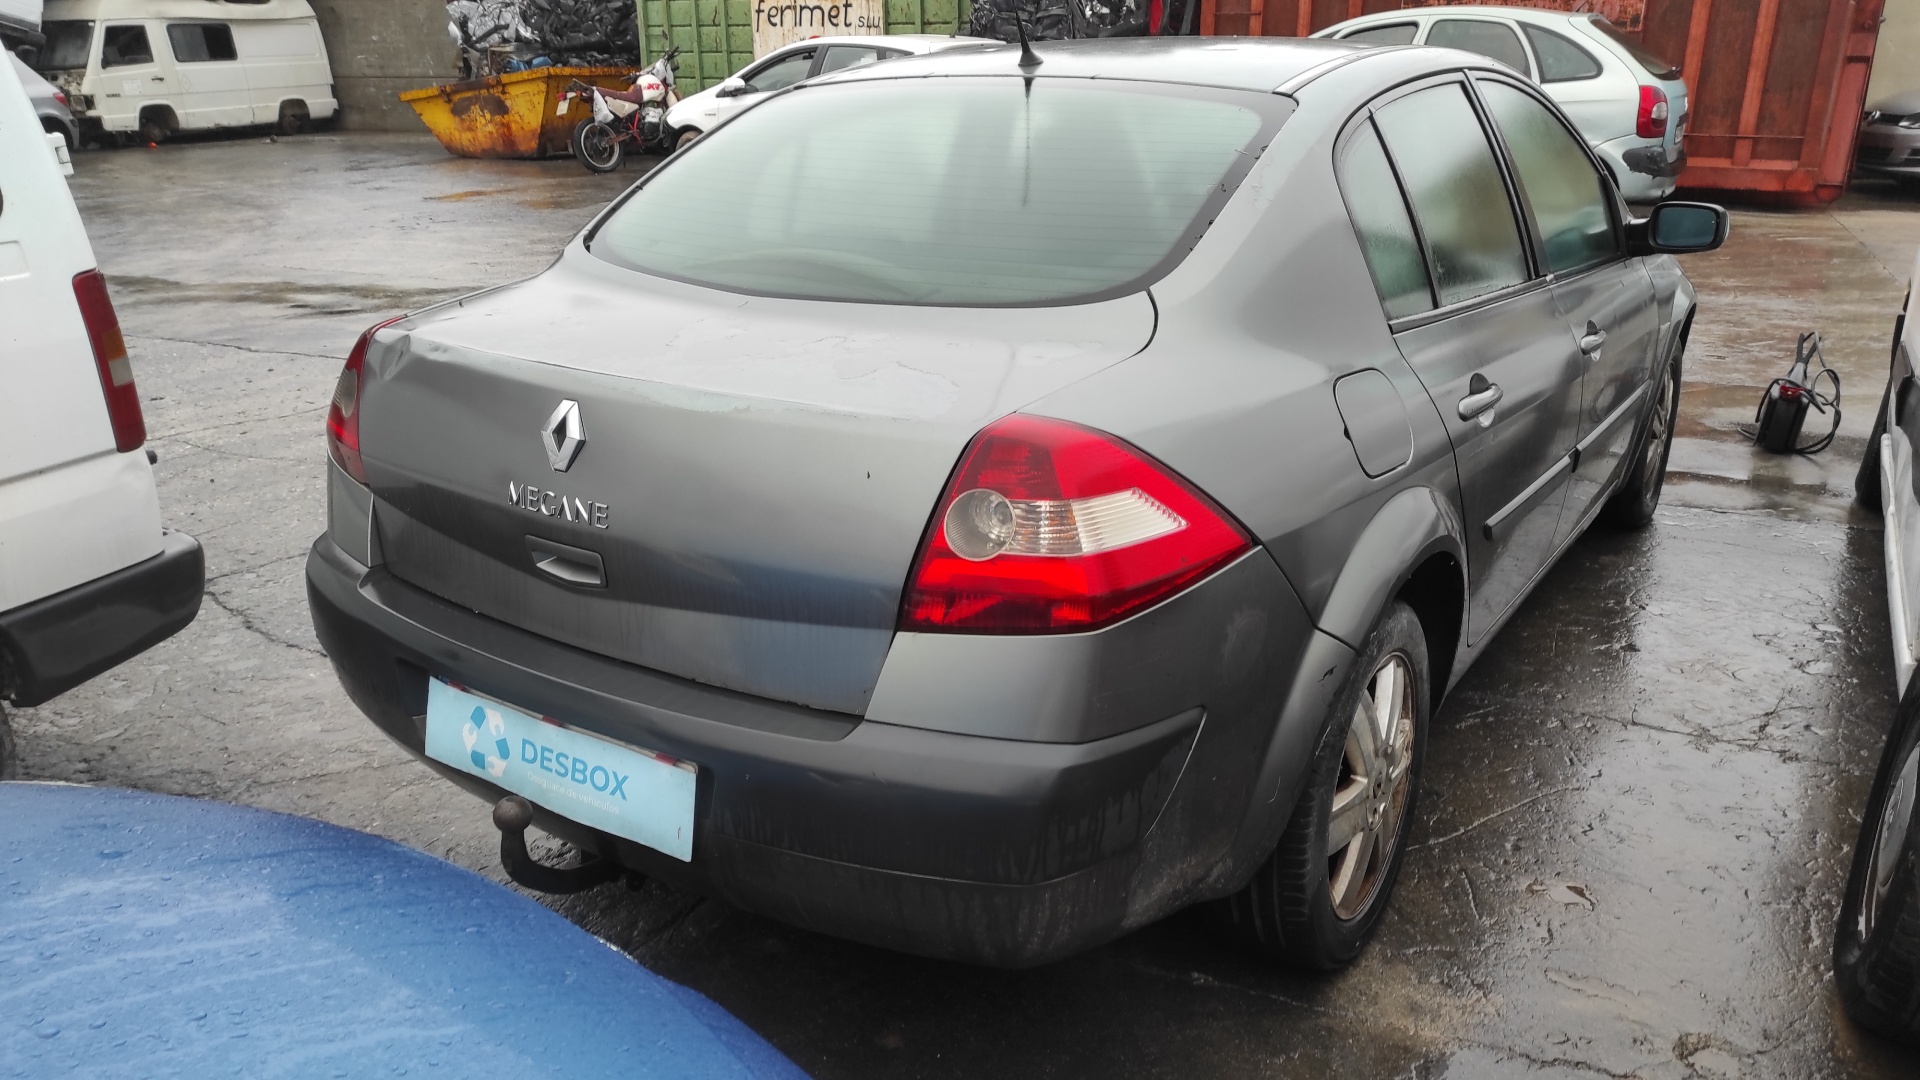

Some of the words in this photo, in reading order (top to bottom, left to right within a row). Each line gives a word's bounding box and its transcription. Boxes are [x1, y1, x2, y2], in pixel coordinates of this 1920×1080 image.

[508, 480, 609, 529] MEGANE
[521, 738, 629, 801] DESBOX
[527, 771, 565, 793] Desguace
[566, 788, 578, 799] de
